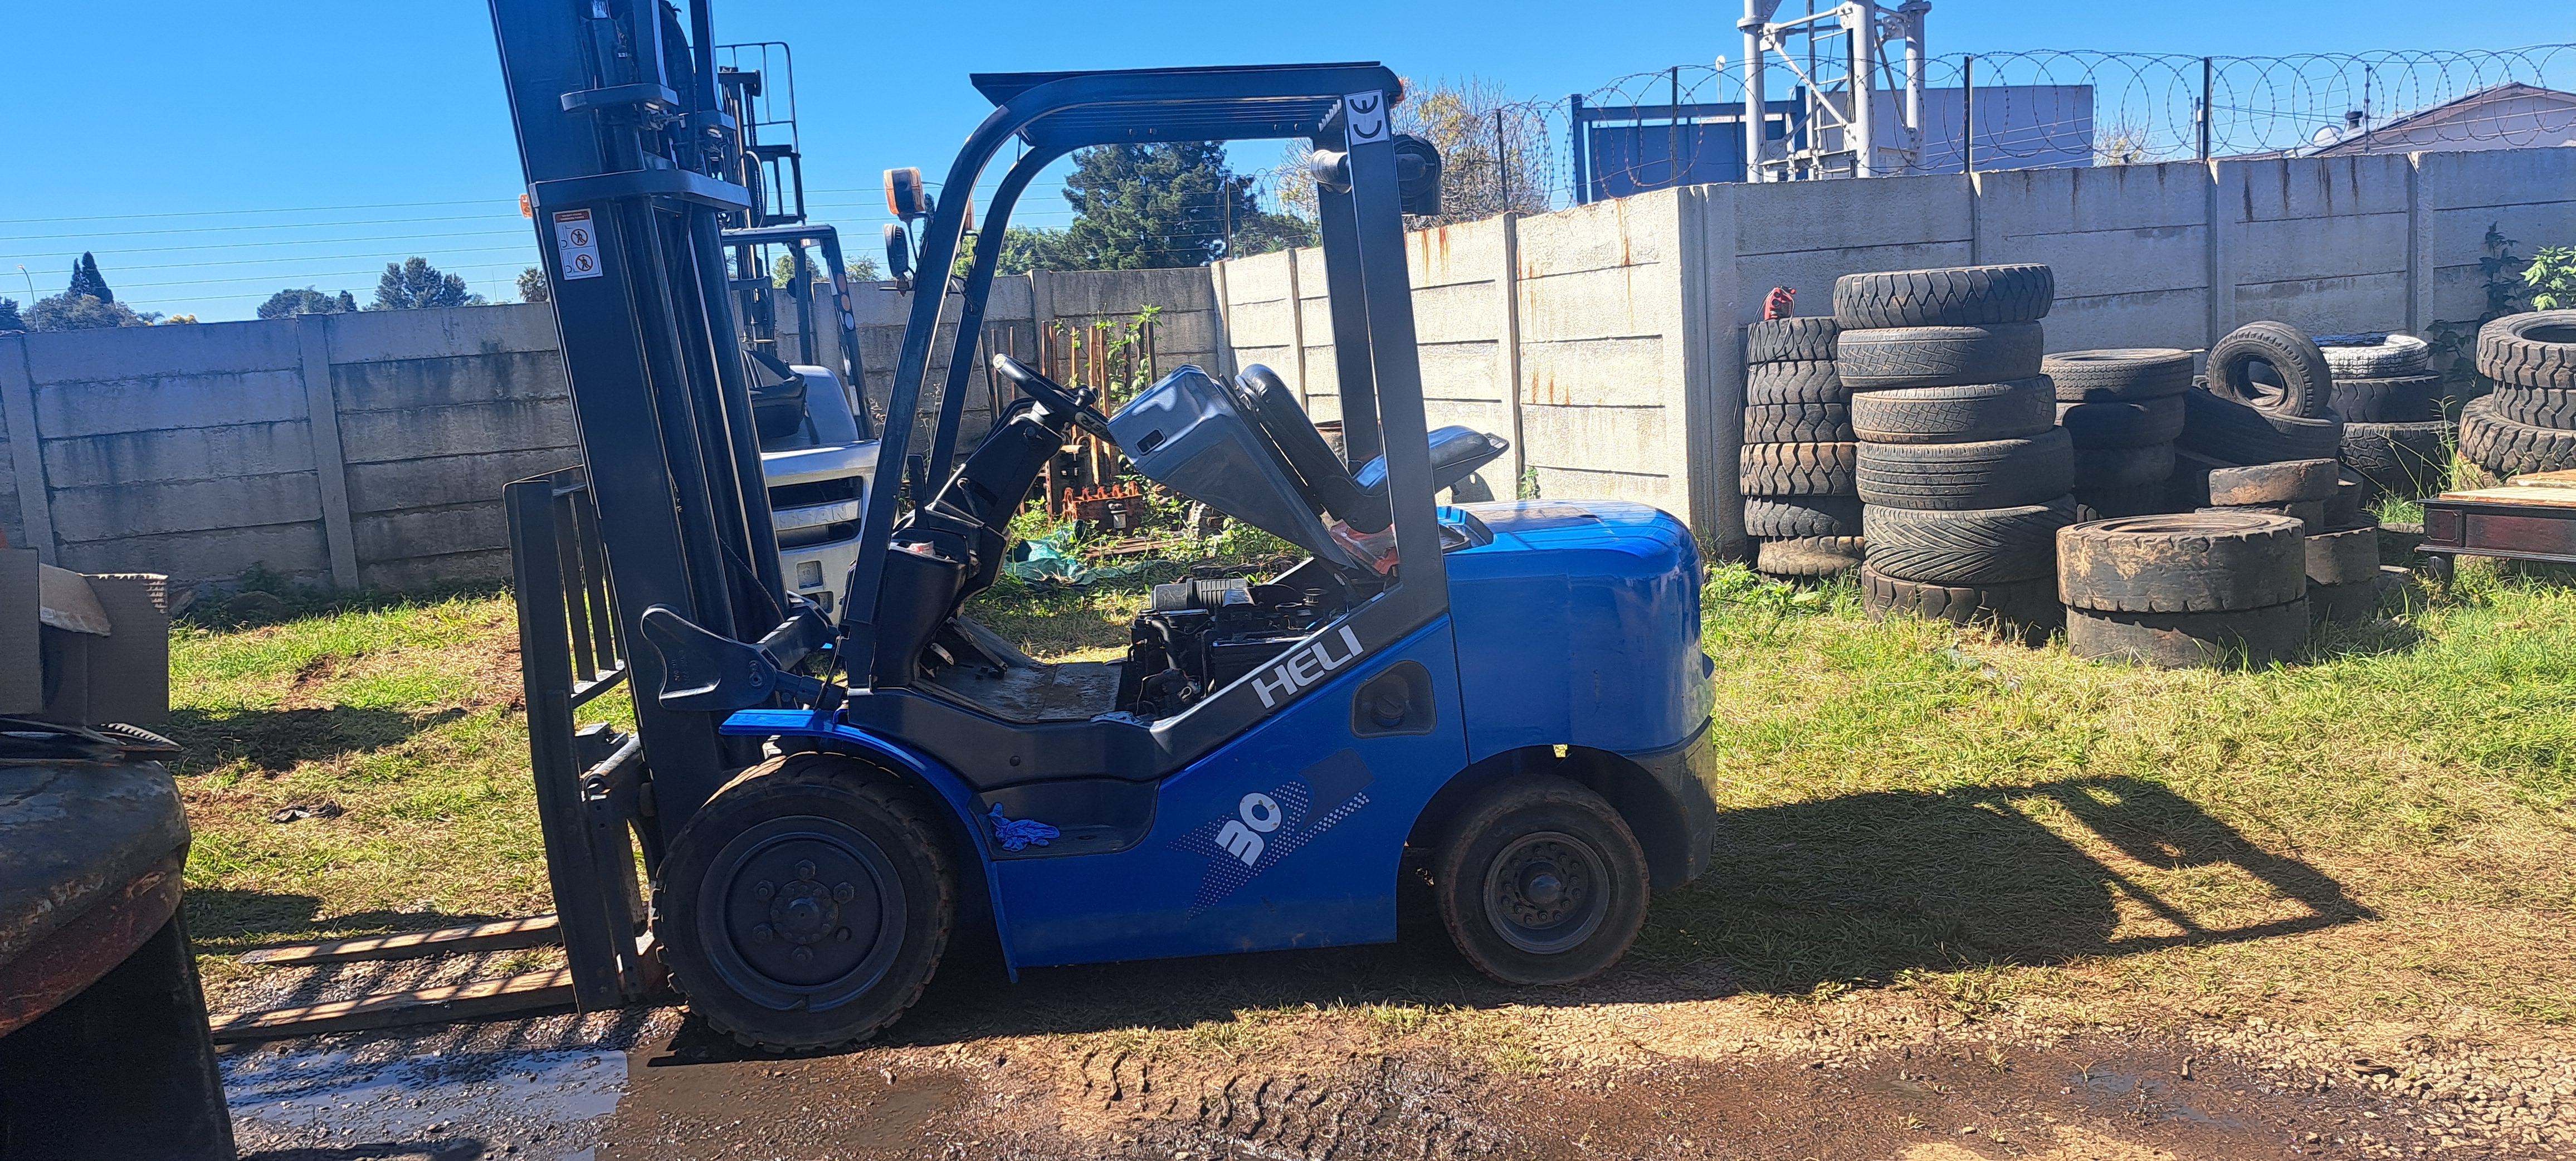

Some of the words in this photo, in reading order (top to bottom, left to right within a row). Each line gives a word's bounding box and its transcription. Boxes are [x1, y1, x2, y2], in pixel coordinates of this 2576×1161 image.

[1349, 95, 1382, 139] CE
[773, 504, 848, 529] ISSAN
[1251, 625, 1364, 709] HELI
[1214, 792, 1282, 867] 30
